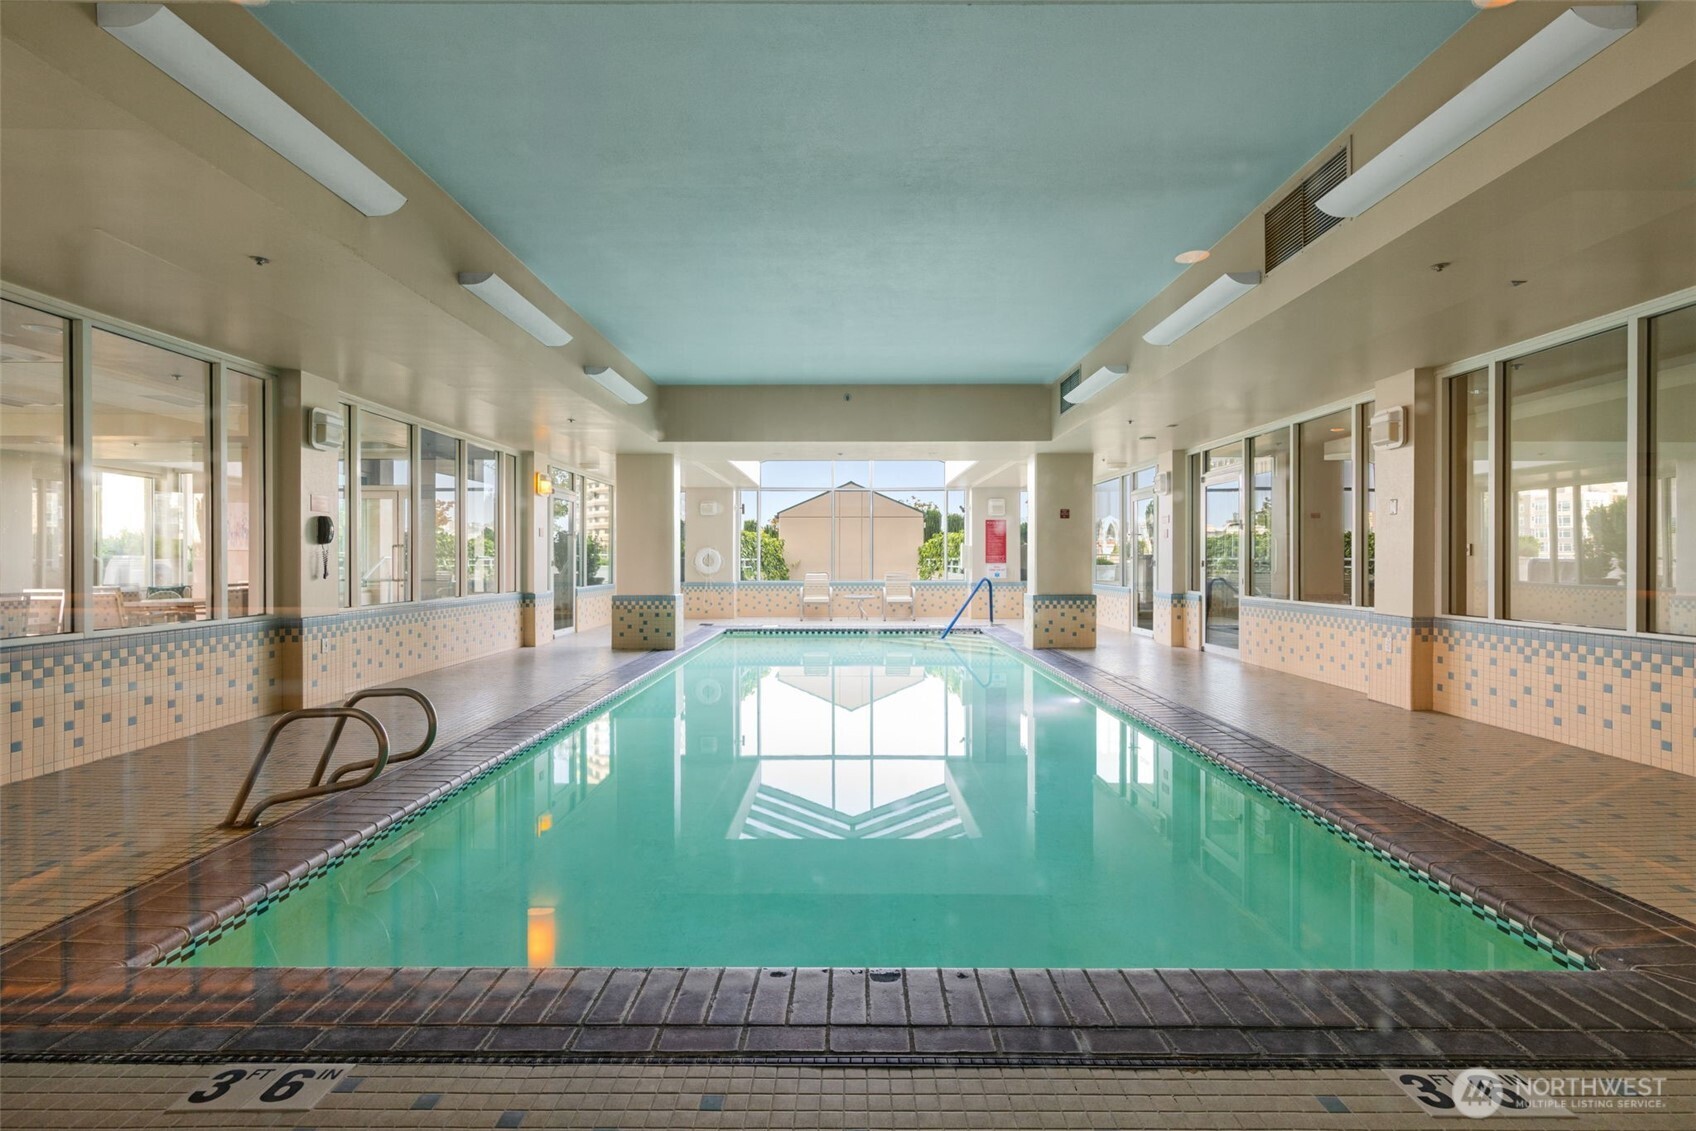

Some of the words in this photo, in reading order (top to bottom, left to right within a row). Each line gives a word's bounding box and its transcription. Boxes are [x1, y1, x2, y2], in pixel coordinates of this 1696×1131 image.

[188, 1069, 247, 1103] 3
[247, 1069, 276, 1080] FT
[259, 1069, 316, 1102] 6
[316, 1069, 344, 1080] IN
[1399, 1074, 1455, 1109] 3
[1428, 1074, 1454, 1086] FT
